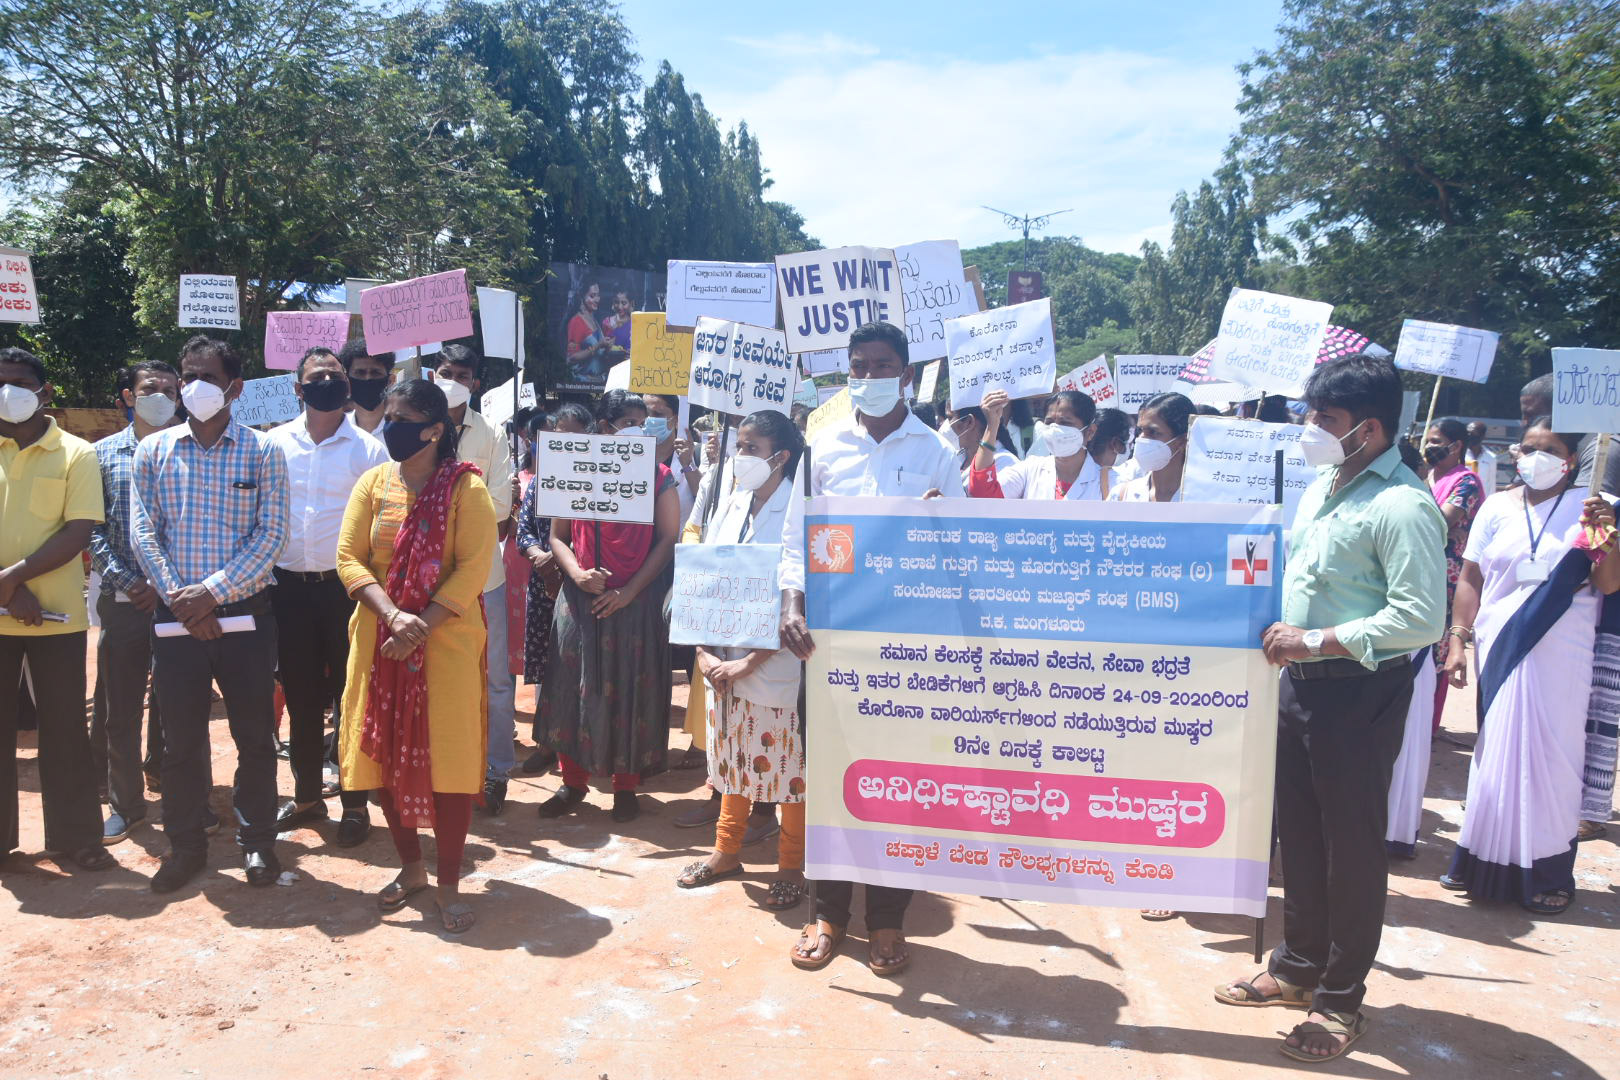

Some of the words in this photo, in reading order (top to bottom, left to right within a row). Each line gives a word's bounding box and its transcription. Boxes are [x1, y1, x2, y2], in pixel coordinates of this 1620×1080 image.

[781, 264, 824, 297] WE
[832, 258, 893, 292] WANT
[798, 298, 889, 337] JUSTICE
[696, 331, 729, 355] ಜನರ
[734, 334, 793, 369] ಸೇವೆಯೇ
[1009, 337, 1044, 354] ಚಪ್ಪಾಳೆ
[958, 376, 979, 389] ಬೇಡ
[1019, 364, 1043, 377] ನೀಡಿ
[1081, 365, 1107, 388] ಬೇಕು
[1120, 362, 1154, 376] ಸಮಾನ
[694, 361, 745, 407] ಆರೋಗ್ಯ
[753, 373, 787, 403] ಸೇವೆ
[548, 439, 592, 453] ಜೀತ
[1226, 427, 1264, 440] ಸಮಾನ
[572, 460, 622, 474] ಸಾಕು
[1206, 449, 1243, 461] ಸಮಾನ
[541, 475, 593, 492] ಸೇವಾ
[602, 480, 648, 499] ಭದ್ರತೆ
[1212, 470, 1241, 483] ಸೇವಾ
[571, 496, 619, 512] ಬೇಕು
[907, 528, 962, 544] ಕರ್ನಾಟಕ
[968, 528, 998, 552] ರಾಜ್ಯ
[1004, 529, 1057, 554] ಆರೋಗ್ಯ
[1063, 530, 1095, 553] ಮತ್ತು
[1102, 530, 1167, 556] ವೈದ್ಯಕೀಯ
[864, 552, 893, 575] ಶಿಕ್ಷಣ
[900, 554, 936, 571] ಇಲಾಖೆ
[942, 555, 978, 576] ಗುತ್ತಿಗೆ
[984, 557, 1015, 578] ಮತ್ತು
[1021, 557, 1091, 581] ಹೊರಗುತ್ತಿಗೆ
[1097, 558, 1144, 577] ನೌಕರರ
[1151, 562, 1182, 581] ಸಂಘ
[1189, 561, 1213, 582] (ರಿ)
[894, 582, 962, 600] ಸಂಯೋಜಿತ
[968, 587, 1031, 603] ಭಾರತೀಯ
[1097, 591, 1128, 609] ಸಂಘ
[1135, 591, 1180, 612] (BMS)
[980, 613, 1008, 630] ದ.ಕ.
[1013, 615, 1085, 633] ಮಂಗಳೂರು
[880, 643, 928, 662] ಸಮಾನ
[934, 645, 983, 673] ಕೆಲಸಕ್ಕೆ
[990, 648, 1040, 668] ಸಮಾನ
[1046, 650, 1095, 673] ವೇತನ,
[1102, 652, 1144, 674] ಸೇವಾ
[1151, 655, 1191, 681] ಭದ್ರತೆ
[828, 668, 860, 692] ಮತ್ತು
[866, 671, 901, 690] ಇತರ
[907, 672, 986, 694] ಬೇಡಿಕೆಗಳಿಗೆ
[992, 678, 1042, 701] ಆಗ್ರಹಿಸಿ
[1049, 682, 1105, 702] ದಿನಾಂಕ
[1112, 688, 1249, 709] 24-09-2020ರಿಂದ
[858, 698, 924, 719] ಕೊರೊನಾ
[1063, 711, 1157, 739] ನಡೆಯುತ್ತಿರುವ
[1164, 717, 1213, 746] ಮುಷ್ಕರ
[954, 735, 990, 756] 9ನೇ
[999, 738, 1043, 769] ದಿನಕ್ಕೆ
[1052, 744, 1105, 774] ಕಾಲಿಟ್ಟ
[1088, 786, 1208, 838] ಮುಷ್ಕರ
[886, 839, 940, 868] ಚಪ್ಪಾಳೆ
[949, 844, 989, 867] ಬೇಡ
[998, 846, 1116, 885] ಸೌಲಭ್ಯಗಳನ್ನು
[1124, 858, 1175, 881] ಕೊಡಿ
